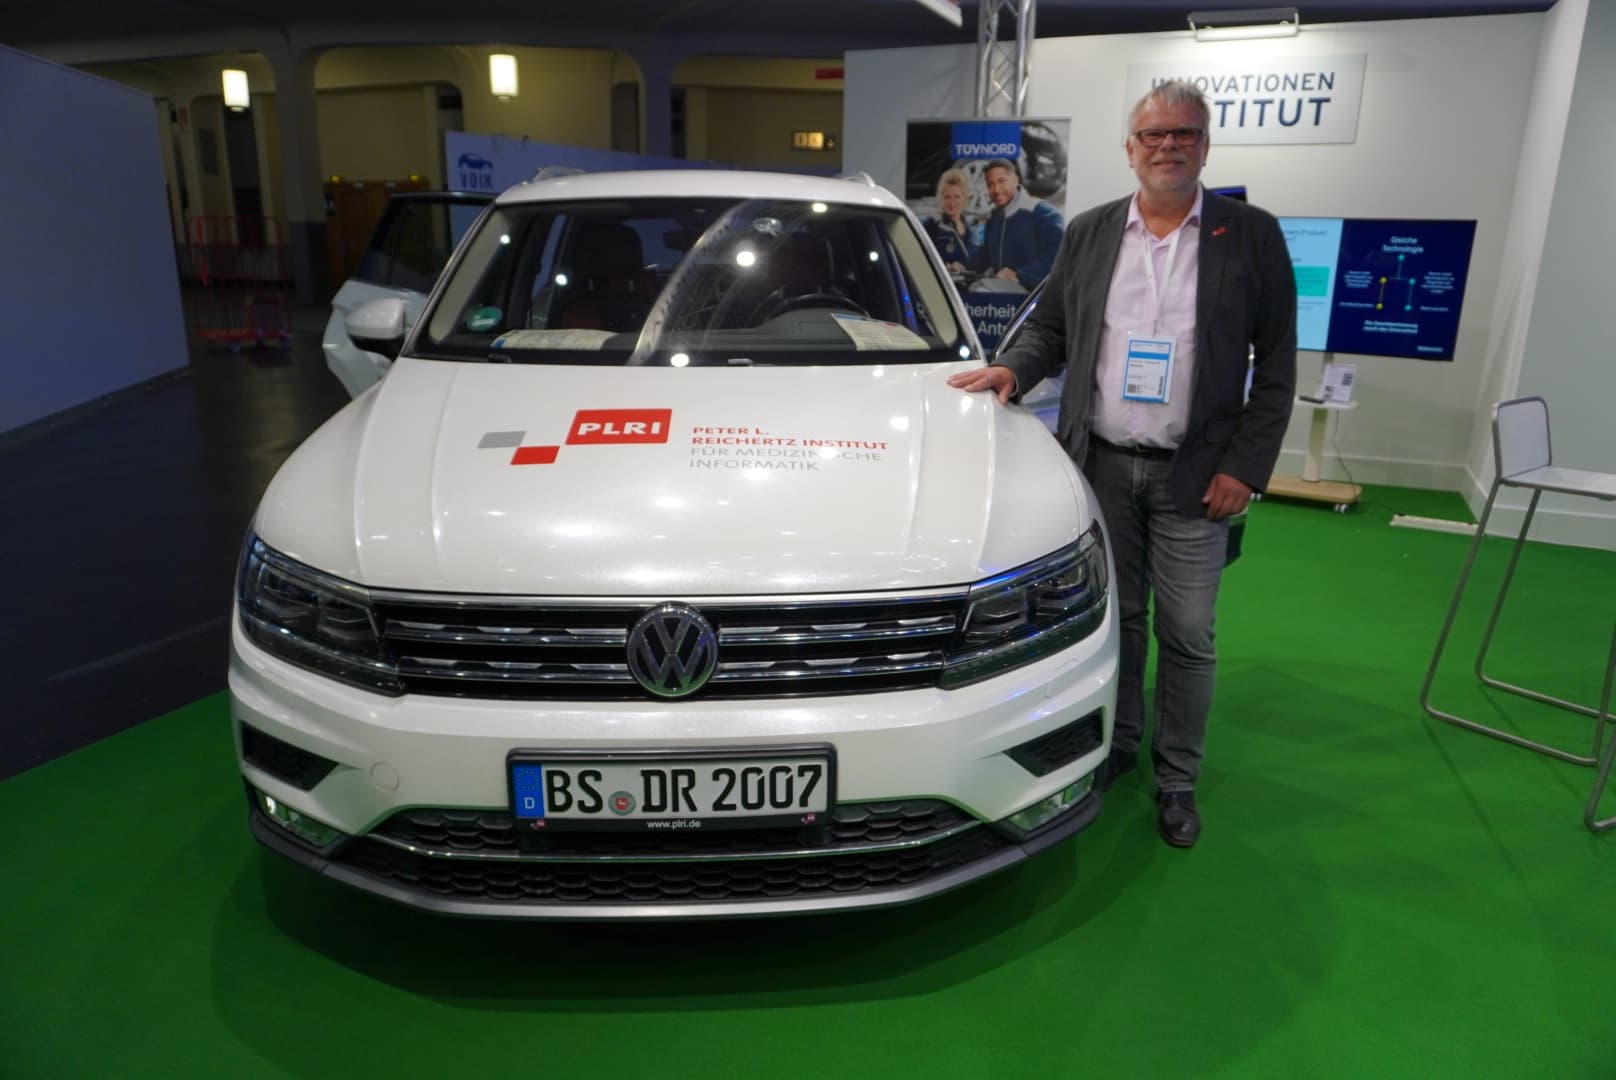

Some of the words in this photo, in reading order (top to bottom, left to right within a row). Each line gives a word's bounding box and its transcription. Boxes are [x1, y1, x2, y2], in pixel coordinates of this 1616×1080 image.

[1214, 97, 1331, 128] TITUT
[965, 302, 1017, 318] herheit
[577, 421, 661, 436] PLRI
[692, 426, 749, 435] PETER
[755, 427, 769, 435] L.
[692, 437, 798, 447] REICHERTZ
[803, 439, 889, 450] INSTITUT
[690, 446, 729, 457] FÜR
[735, 448, 882, 462] MEDIZINCHE
[689, 459, 819, 471] INFORMATIK
[524, 797, 535, 809] D
[546, 768, 603, 814] BS
[640, 768, 698, 813] DR
[711, 764, 822, 811] 2007
[646, 819, 702, 830] www.plri.de
